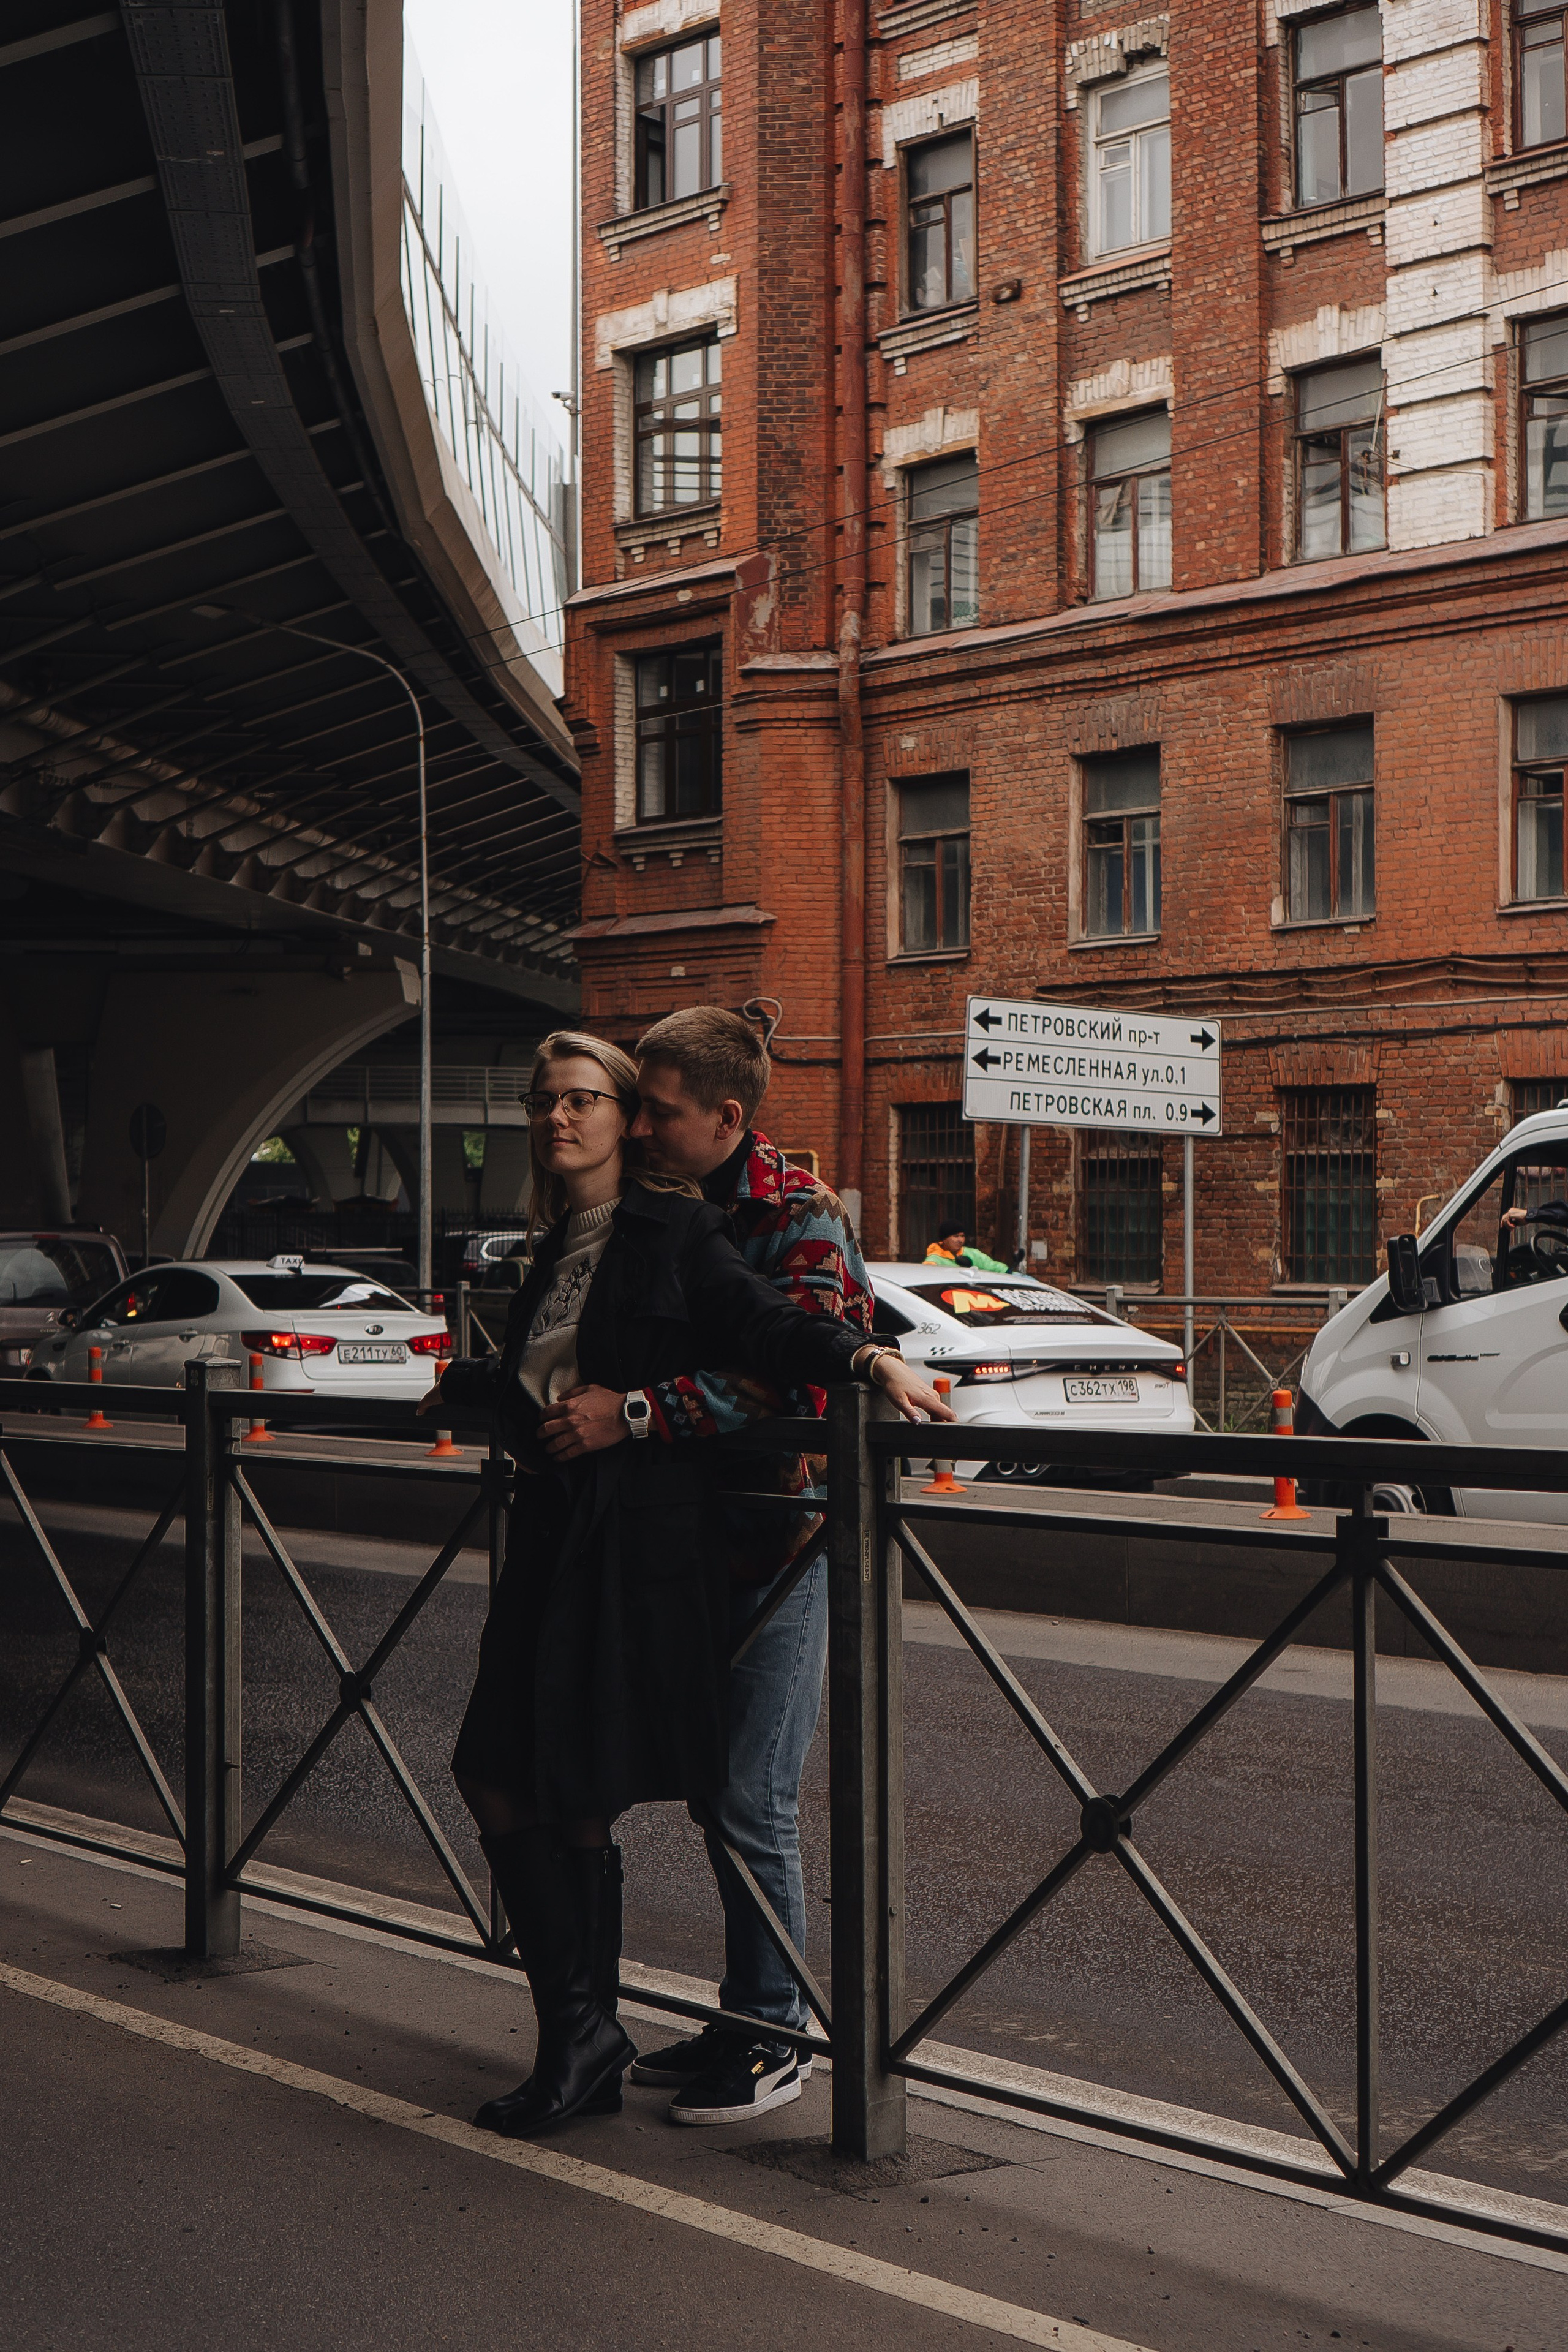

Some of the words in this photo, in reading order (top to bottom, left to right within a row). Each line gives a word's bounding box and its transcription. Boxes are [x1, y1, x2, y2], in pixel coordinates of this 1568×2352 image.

[1008, 1012, 1123, 1042] ПЕТРОВСКИЙ
[1129, 1030, 1160, 1048] пр-т
[1003, 1052, 1136, 1080] РЕМЕСЛЕННАЯ
[1010, 1091, 1127, 1118] ПЕТРОВСКАЯ
[1133, 1106, 1156, 1120] пл.
[1166, 1102, 1188, 1122] 0,9
[917, 1321, 941, 1335] 362
